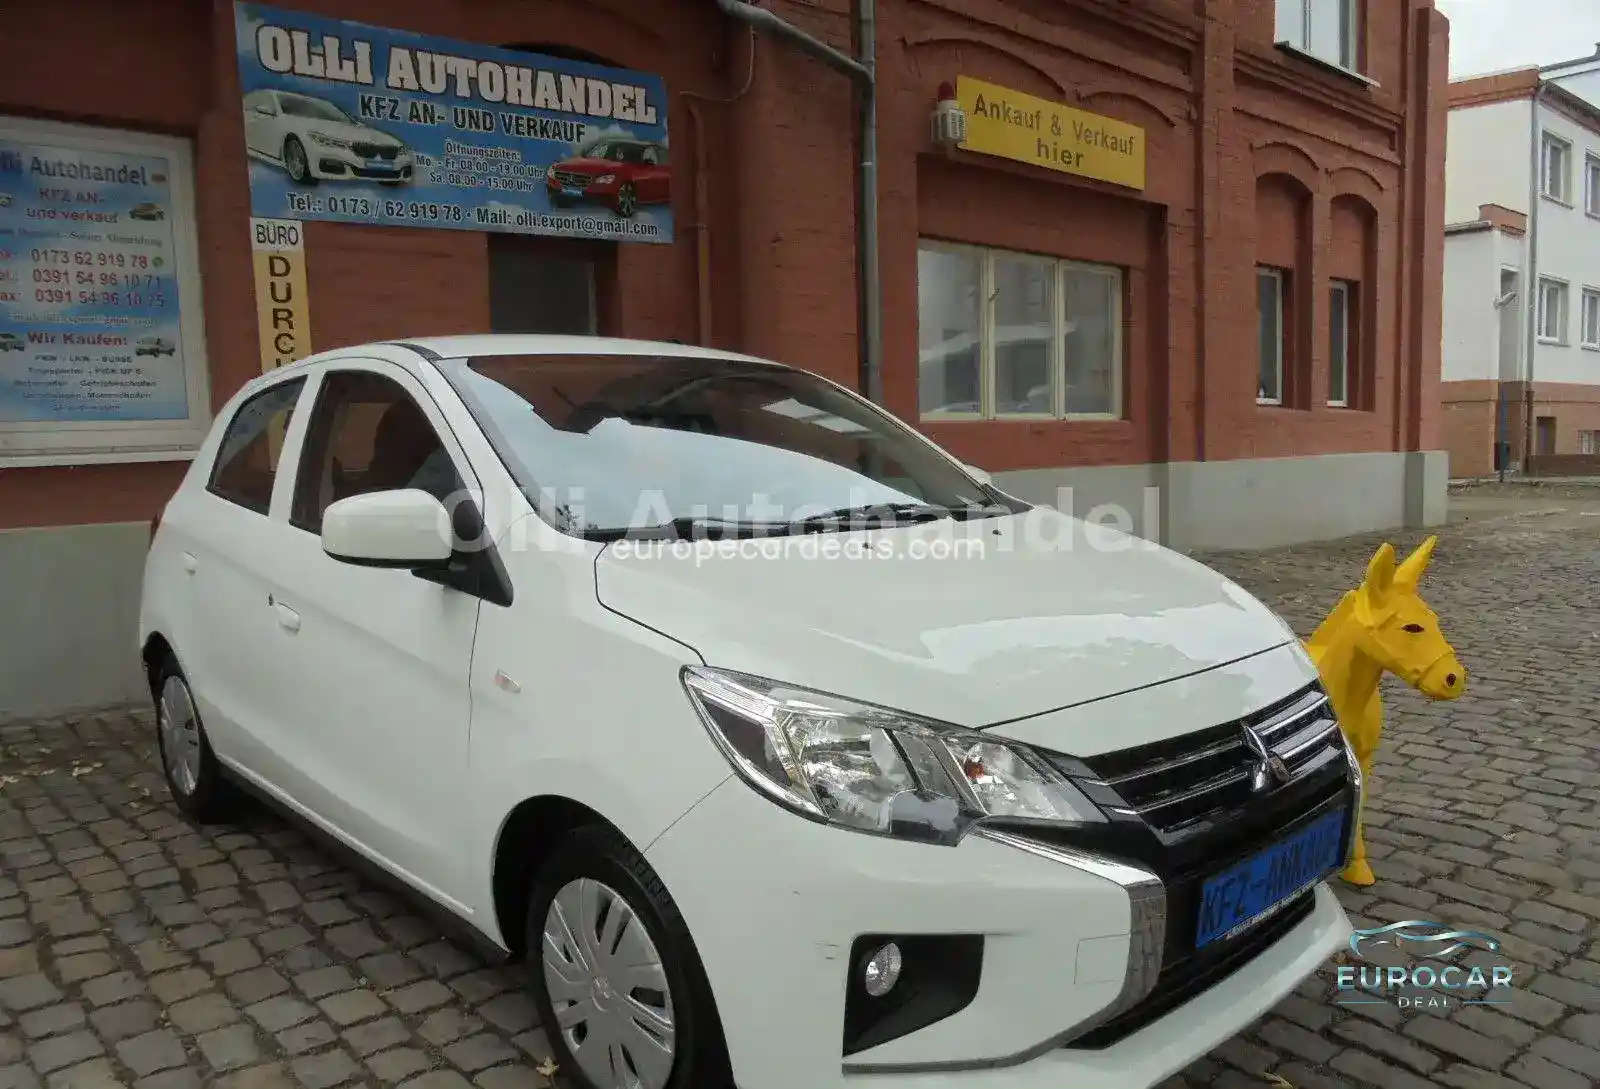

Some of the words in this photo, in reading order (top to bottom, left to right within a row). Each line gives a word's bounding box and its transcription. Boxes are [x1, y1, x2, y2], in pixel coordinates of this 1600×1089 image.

[256, 25, 374, 85] OLLI
[386, 46, 657, 125] AUTOHANDEL
[360, 94, 400, 120] KFZ
[409, 101, 445, 124] AN-
[453, 107, 493, 132] UND
[501, 113, 586, 142] VERKAUF
[974, 94, 1041, 130] Ankauf
[1051, 113, 1062, 137] &
[1073, 119, 1134, 155] Verkauf
[1037, 138, 1084, 167] hier
[30, 156, 147, 186] Autohandel
[516, 181, 533, 192] Uhr
[287, 193, 321, 212] Tel.:
[329, 197, 370, 214] 0173
[385, 201, 404, 217] 62
[410, 204, 438, 219] 919
[443, 206, 461, 221] 78
[477, 207, 511, 224] Mail:
[516, 214, 658, 236] olli.export@gmail.com
[256, 221, 299, 245] BÜRO
[31, 248, 69, 264] 0173
[74, 251, 93, 266] 62
[98, 252, 125, 267] 919
[130, 254, 148, 269] 78
[33, 269, 70, 284] 0391
[76, 270, 94, 284] 54
[100, 272, 117, 286] 96
[124, 274, 139, 288] 10
[144, 274, 160, 290] 71
[35, 288, 72, 303] 0391
[79, 290, 97, 304] 54
[27, 331, 55, 345] Wir
[62, 332, 128, 347] Kaufen:
